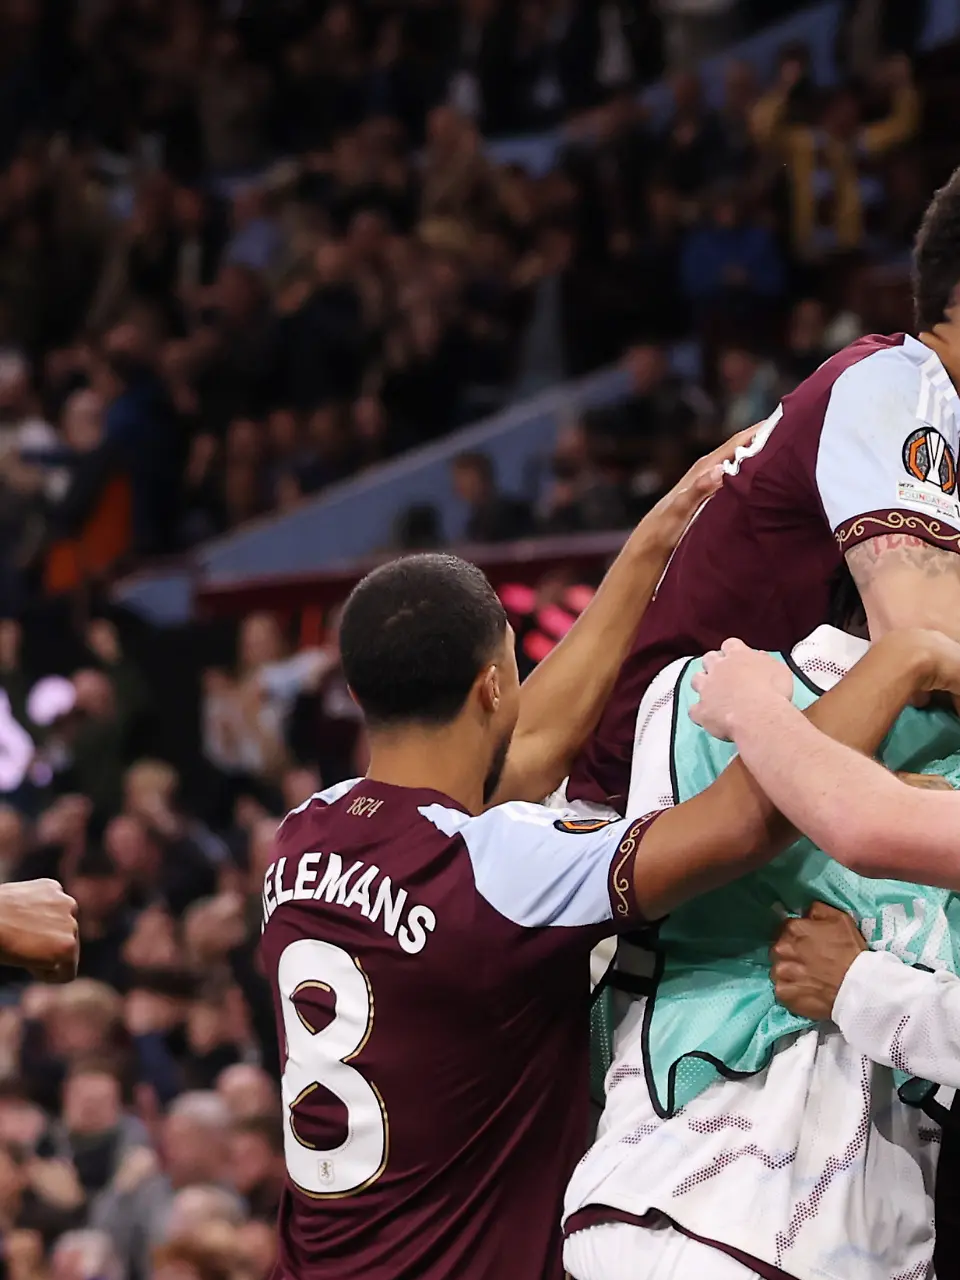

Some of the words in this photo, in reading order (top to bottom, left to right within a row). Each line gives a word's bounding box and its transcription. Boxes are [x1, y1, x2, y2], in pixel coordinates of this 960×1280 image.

[346, 795, 384, 818] 1874
[261, 852, 437, 955] ELEMANS
[277, 938, 389, 1200] 8
